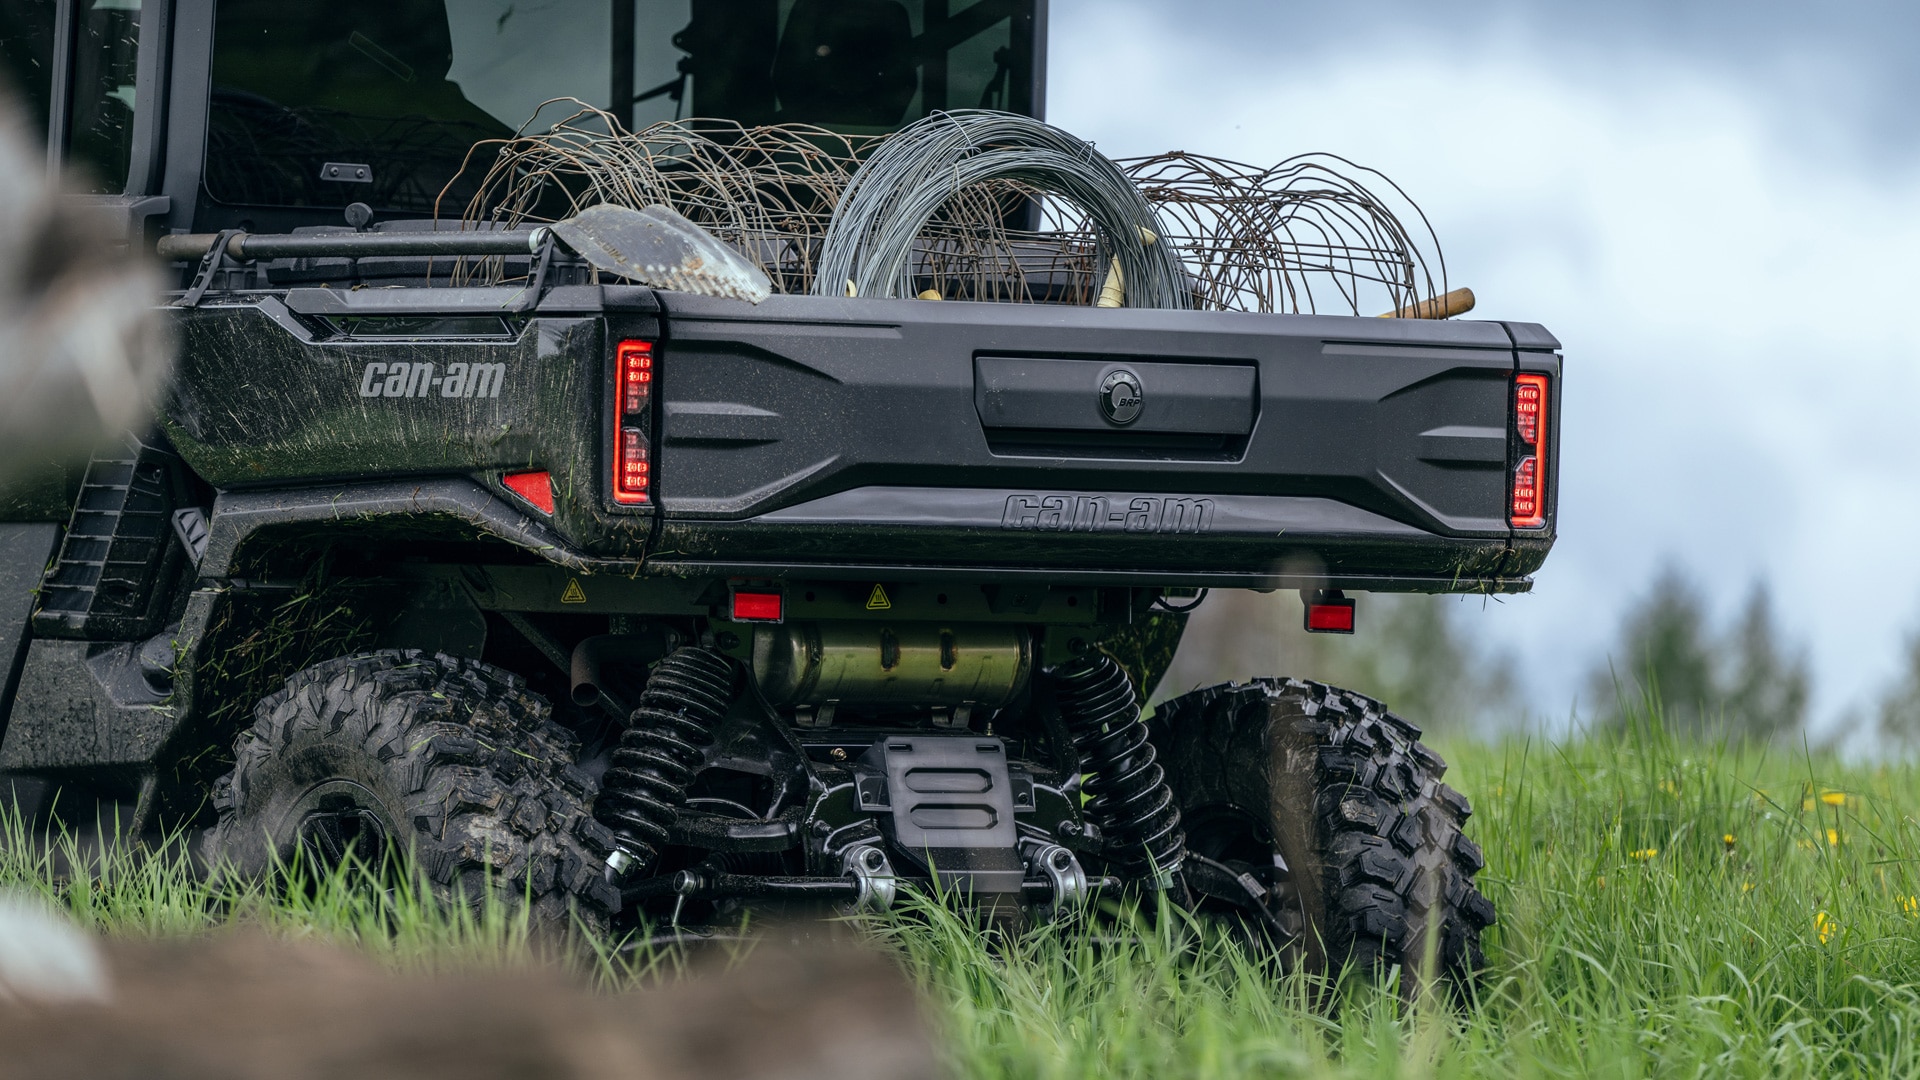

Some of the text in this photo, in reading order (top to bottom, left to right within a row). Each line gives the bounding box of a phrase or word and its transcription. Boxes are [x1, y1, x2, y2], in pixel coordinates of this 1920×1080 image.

[359, 362, 506, 398] can-am
[1119, 398, 1140, 407] BRP
[1001, 494, 1215, 533] can-am
